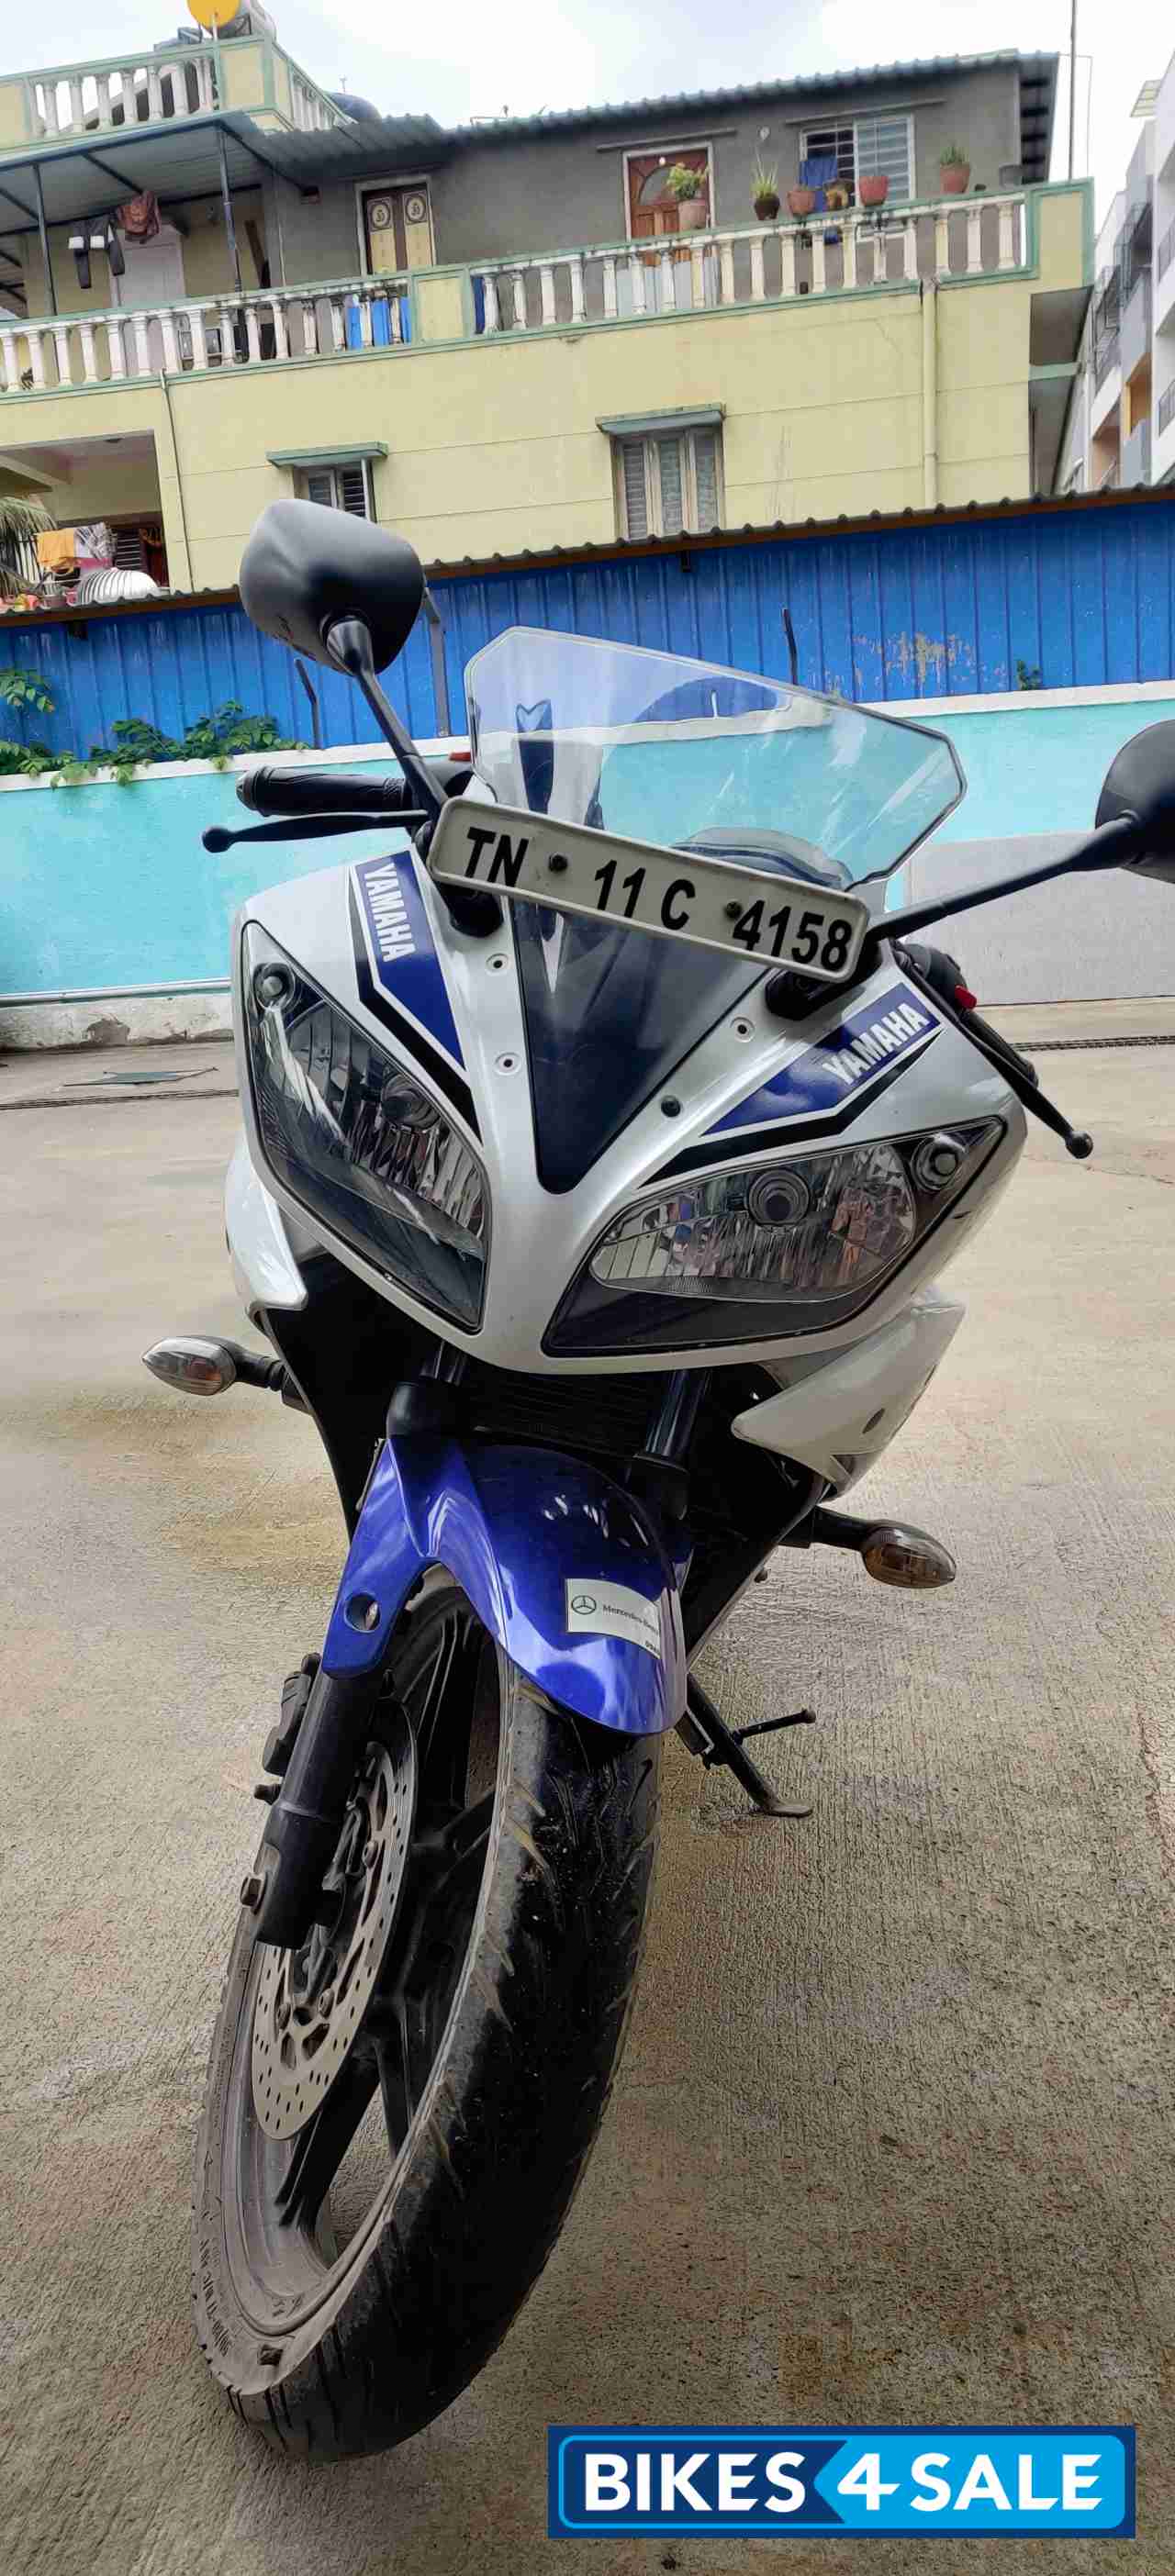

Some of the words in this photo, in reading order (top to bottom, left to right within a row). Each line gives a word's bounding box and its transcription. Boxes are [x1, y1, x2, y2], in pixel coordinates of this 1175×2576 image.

[364, 862, 417, 963] YAMAHA
[464, 827, 530, 887] TN
[595, 859, 646, 919] 11
[660, 879, 696, 931] C
[733, 899, 852, 971] 4158
[822, 1003, 931, 1085] YAMAHA
